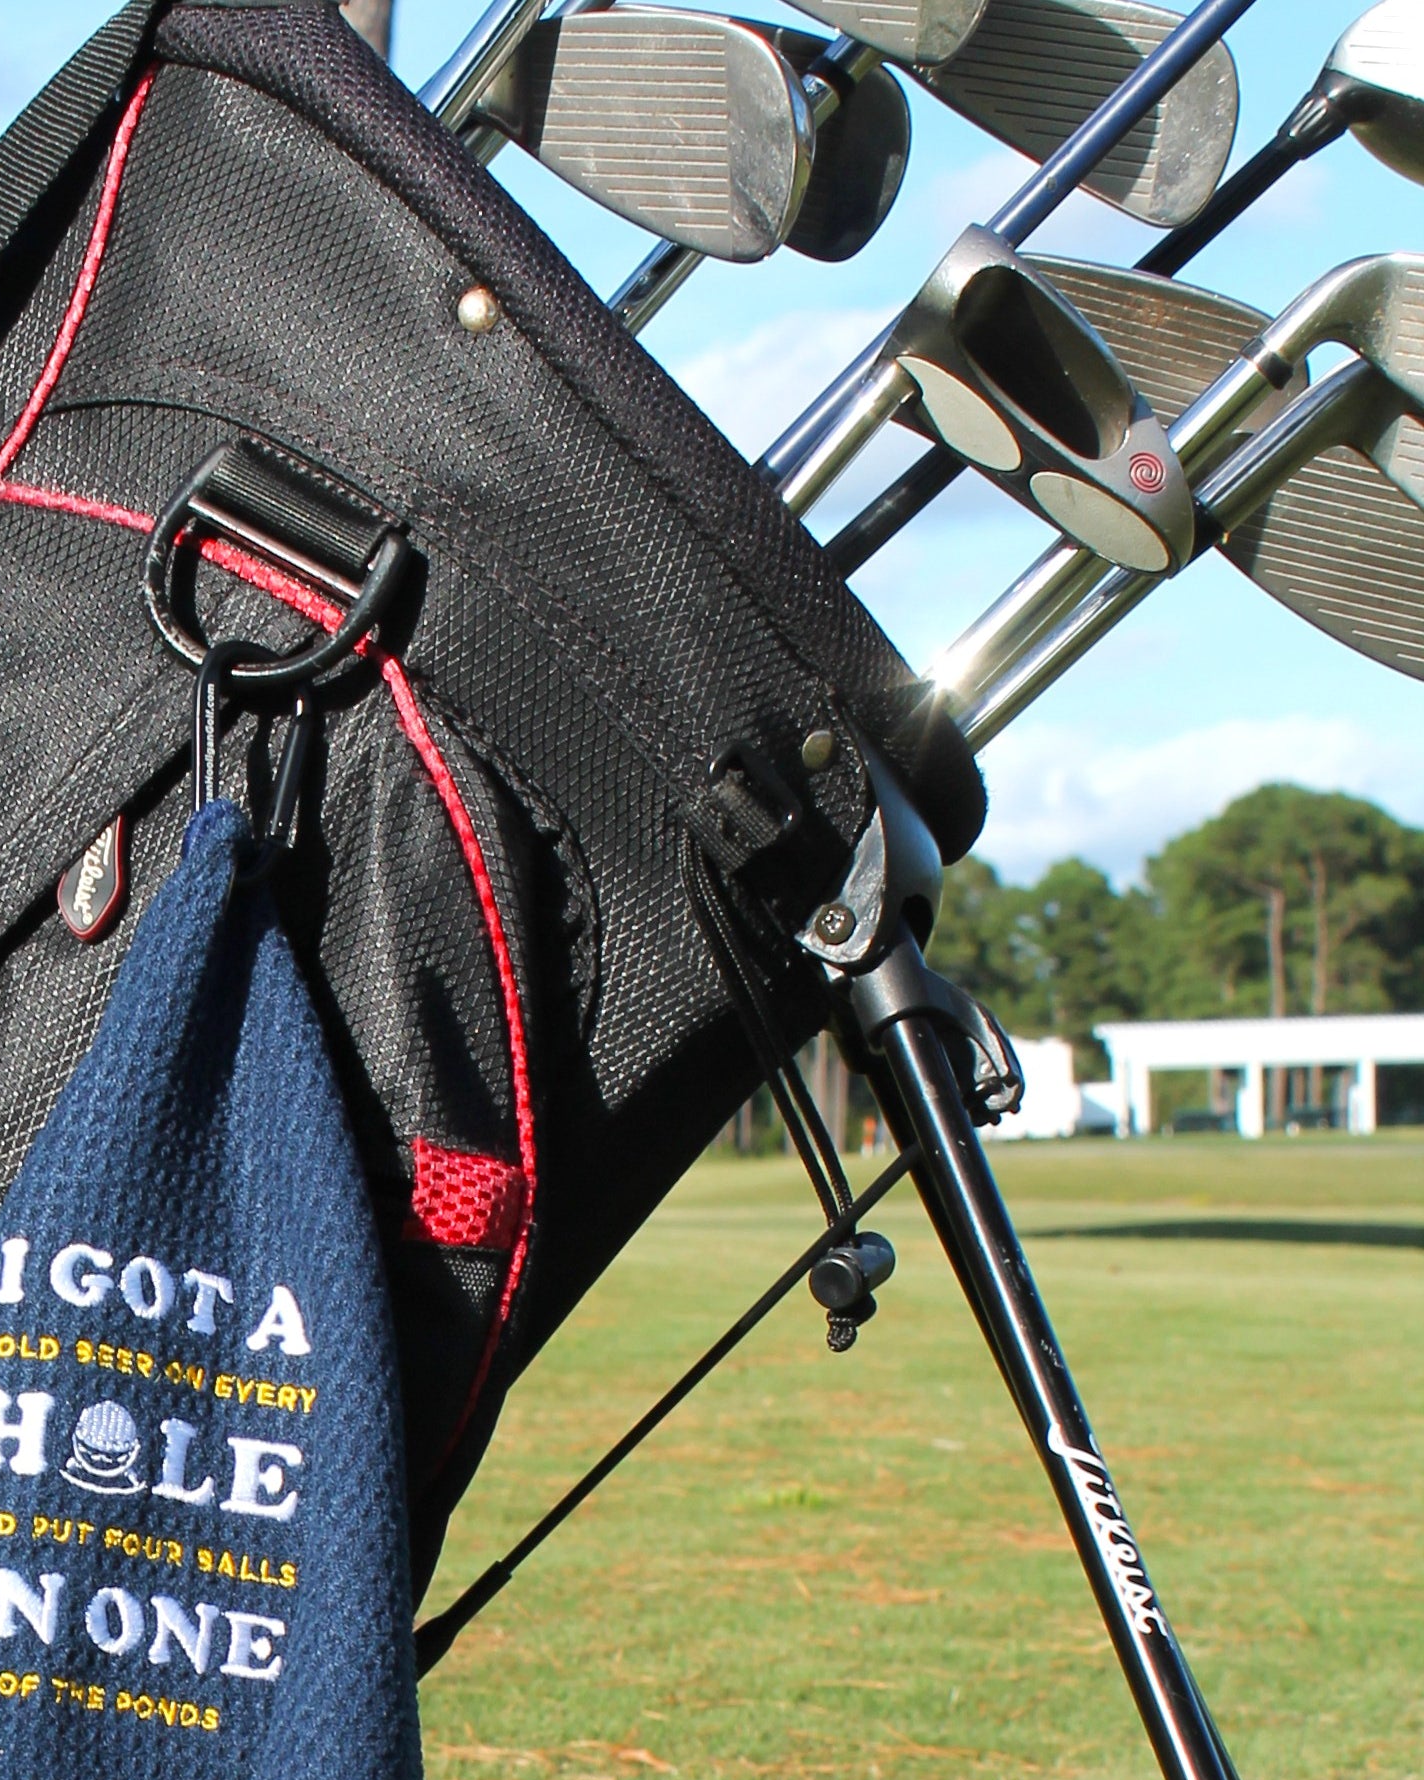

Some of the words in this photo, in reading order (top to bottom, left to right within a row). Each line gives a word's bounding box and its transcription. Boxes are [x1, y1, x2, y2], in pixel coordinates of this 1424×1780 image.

[50, 1243, 234, 1335] GOT
[246, 1285, 312, 1356] A
[75, 1339, 154, 1378] BEER
[164, 1361, 205, 1391] ON
[214, 1373, 317, 1413] EVERY
[32, 1515, 95, 1545] PUT
[104, 1526, 184, 1567] FOUR
[197, 1548, 298, 1588] BALLS
[85, 1586, 287, 1681] ONE
[50, 1677, 106, 1711] THE
[116, 1690, 221, 1731] PONDS
